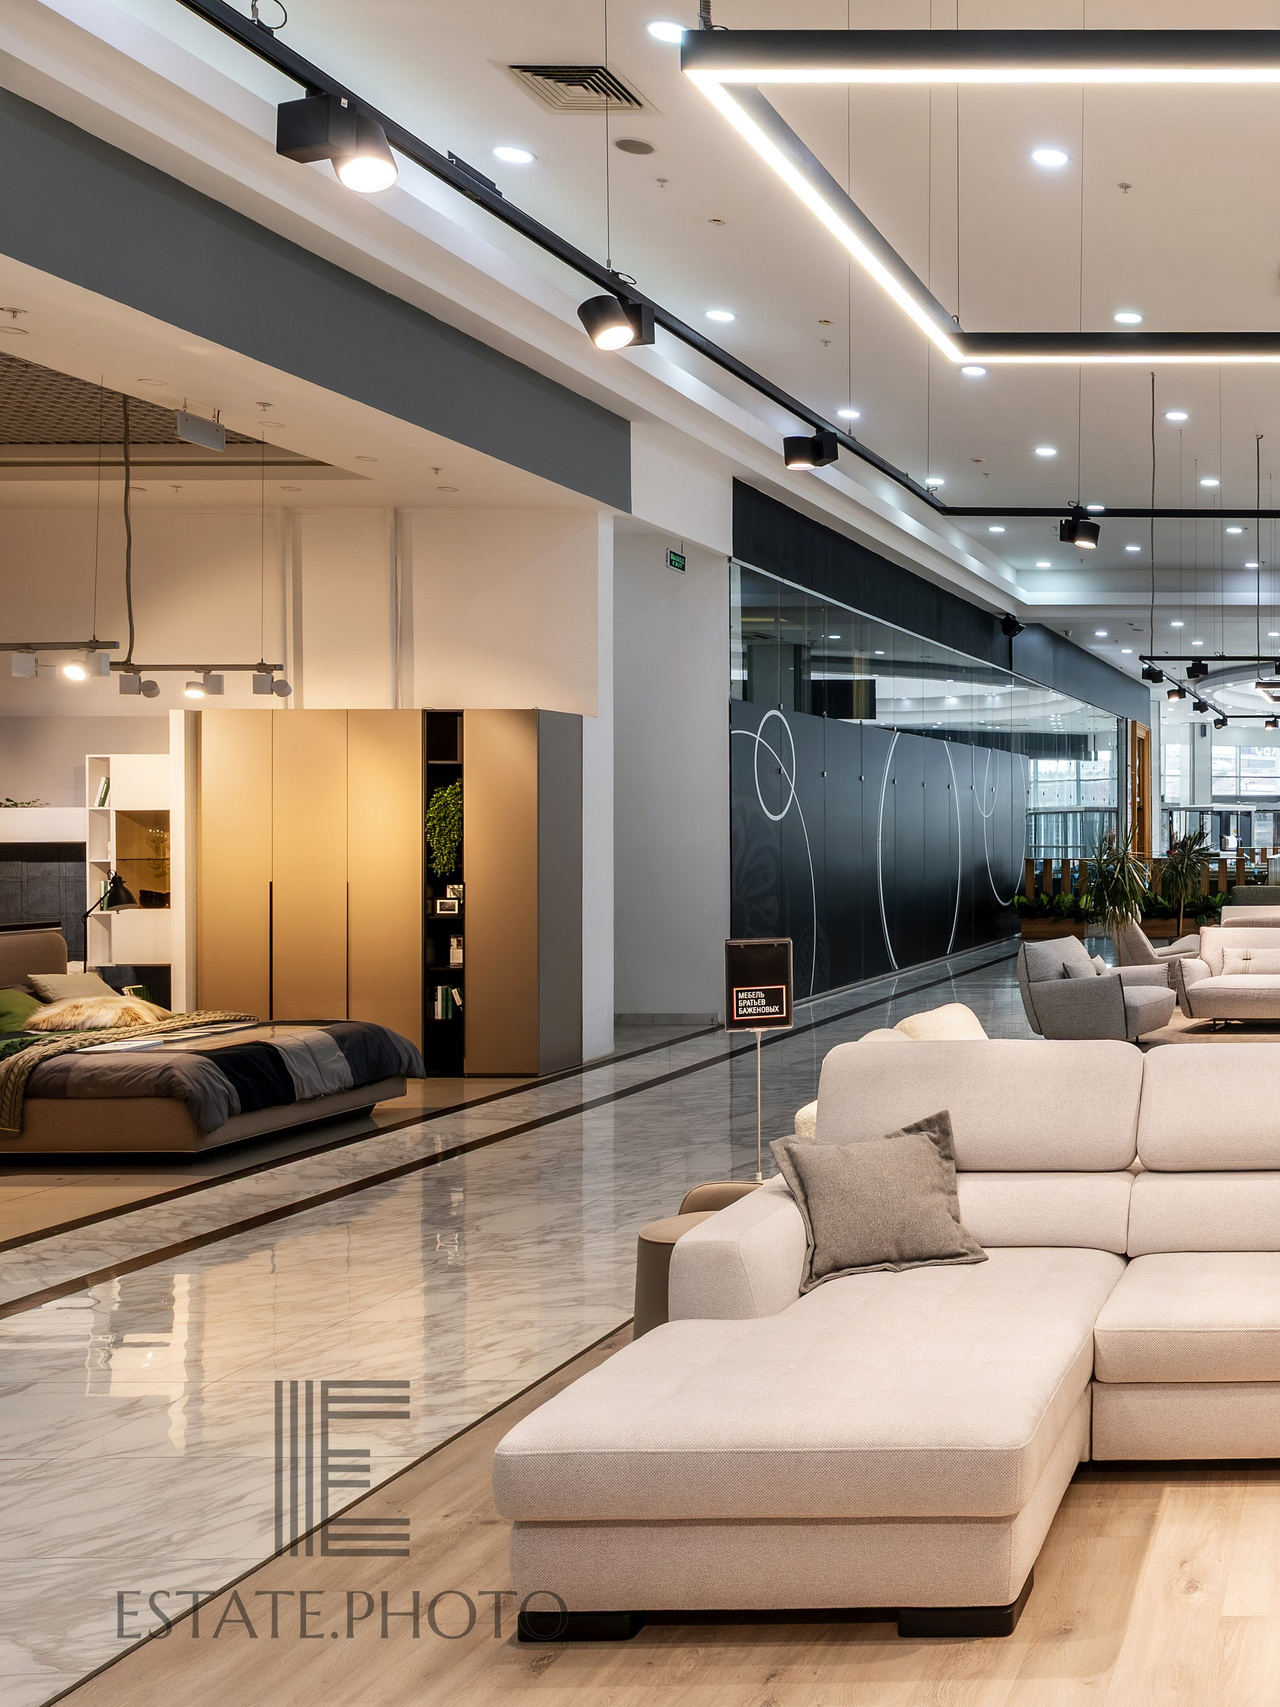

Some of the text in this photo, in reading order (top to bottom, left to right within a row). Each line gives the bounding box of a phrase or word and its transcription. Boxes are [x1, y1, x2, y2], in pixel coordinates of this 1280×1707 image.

[738, 991, 765, 999] МЕБЕЛЬ
[738, 998, 766, 1007] БРАТЬЕВ
[738, 1005, 780, 1015] БАЖЕНОВЫХ
